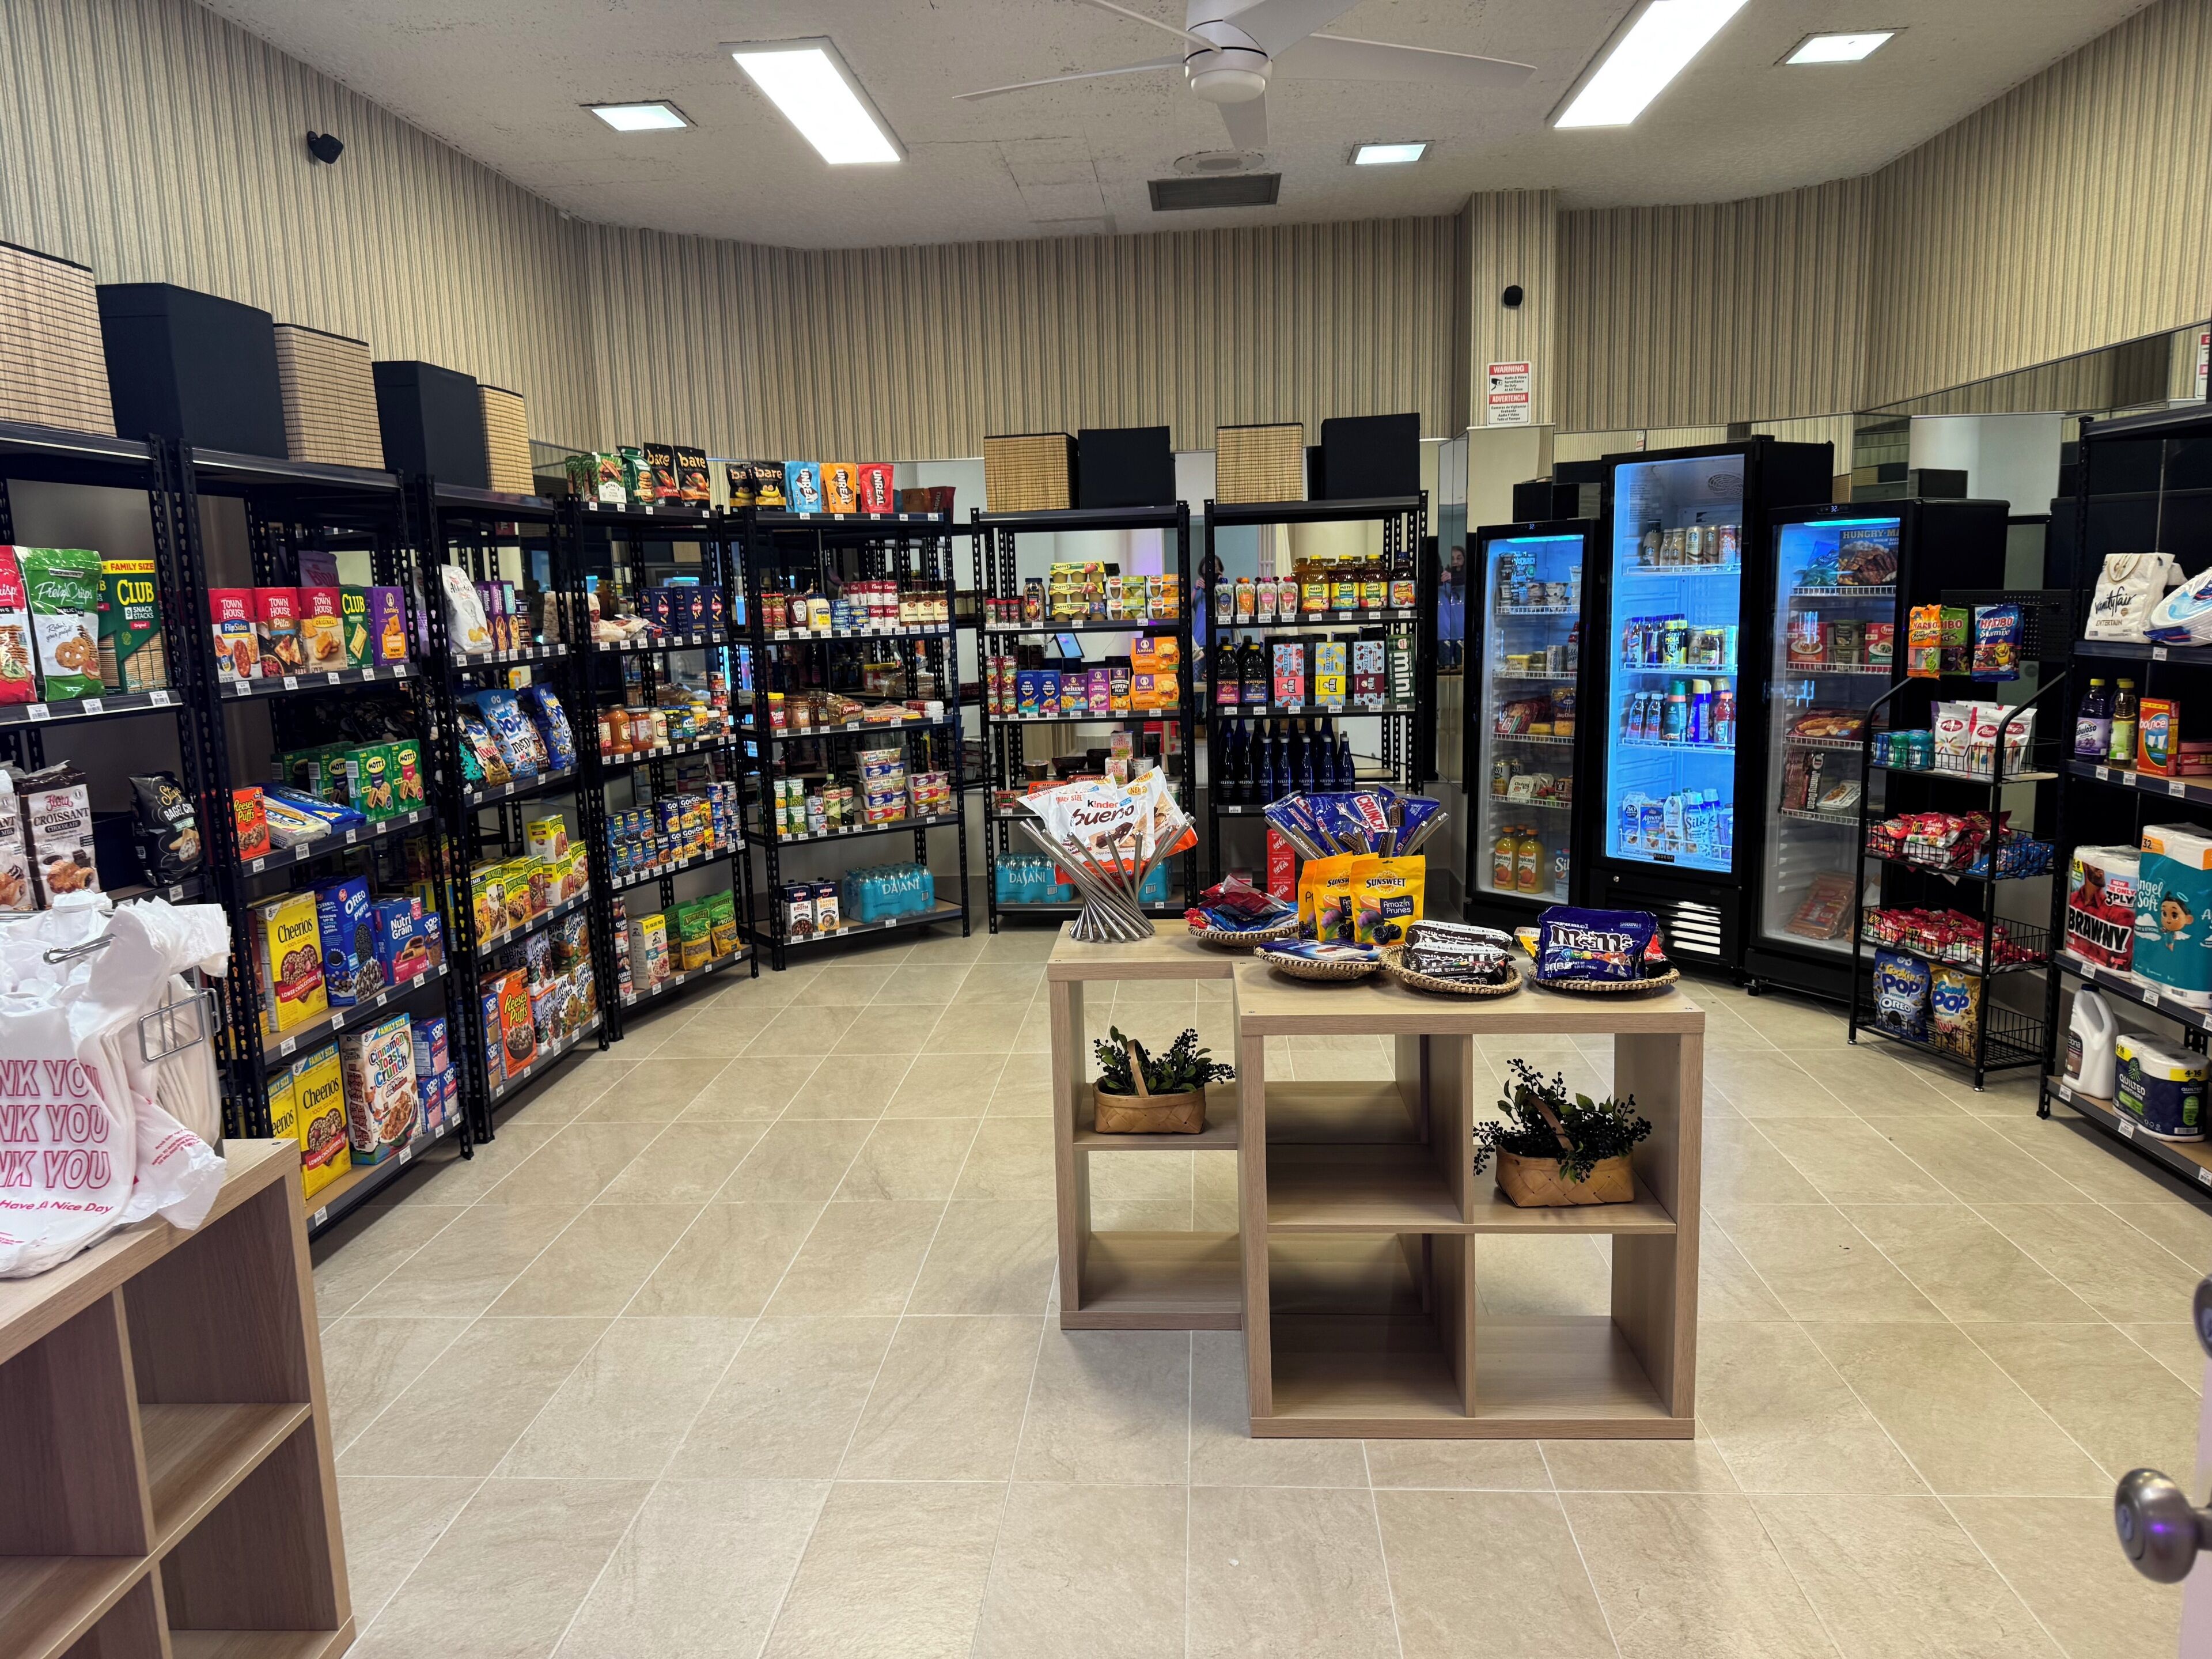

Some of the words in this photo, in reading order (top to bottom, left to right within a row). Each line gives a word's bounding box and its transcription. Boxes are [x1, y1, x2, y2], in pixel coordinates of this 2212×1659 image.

[1494, 365, 1525, 373] WARNING
[1492, 395, 1525, 403] ADVERTENCIA
[647, 449, 670, 466] bare
[678, 452, 706, 468] bare
[755, 467, 782, 479] bare
[800, 468, 817, 505] UNREAL
[835, 469, 853, 505] UNREAL
[873, 469, 883, 506] UNREAL
[111, 563, 137, 571] FAMILY
[138, 563, 154, 571] SIZE
[117, 579, 154, 605] CLUB
[221, 599, 243, 609] TOWN
[268, 598, 289, 608] TOWN
[313, 597, 331, 605] TOWN
[342, 594, 365, 614] CLUB
[127, 608, 132, 618] 9
[222, 608, 245, 619] HOUSE
[270, 607, 290, 617] HOUSE
[314, 605, 333, 615] HOUSE
[383, 607, 399, 615] Annie's
[225, 623, 247, 632] FlipSides
[274, 618, 290, 628] Pita
[1980, 618, 2014, 628] HARIBO
[1980, 629, 2011, 638] Starmix
[1394, 652, 1414, 698] mini
[2139, 717, 2166, 730] bounce
[400, 751, 416, 762] MOTT'S
[368, 760, 385, 770] MOTT'S
[1137, 772, 1152, 782] NEW!
[1808, 771, 1821, 794] Jimmy
[234, 800, 254, 812] Reese's
[1088, 800, 1118, 809] Kinder
[1807, 793, 1816, 809] Dean
[33, 807, 89, 827] CROISSANT
[164, 806, 183, 821] BAGEL
[237, 810, 255, 825] Puffs
[1072, 806, 1134, 825] bueno
[1290, 808, 1312, 831] CRUNCH
[1357, 796, 1385, 832] CRUNCH
[1642, 814, 1663, 823] Almond
[47, 821, 79, 832] CHOCOLATE
[1686, 815, 1707, 830] Silk
[1912, 821, 1923, 832] RITZ
[2142, 838, 2152, 850] 32
[1555, 857, 1570, 872] Sil
[882, 878, 920, 895] DASANI
[1009, 872, 1046, 887] DASANI
[1366, 877, 1407, 888] SUNSWEET
[345, 891, 366, 915] OREO
[2138, 891, 2158, 912] Soft
[354, 902, 369, 921] PUFFS
[1386, 906, 1411, 914] Prunes
[391, 914, 411, 931] Nutri
[718, 916, 734, 926] PROTEIN
[278, 917, 313, 944] Cheerios
[392, 925, 413, 941] Grain
[548, 925, 565, 935] Bites
[692, 930, 710, 940] CRUNCHY
[1885, 964, 1915, 982] Cookie
[281, 988, 295, 998] LOWER
[294, 975, 317, 992] CHOLESTEROL
[580, 975, 591, 992] Bites
[1936, 980, 1968, 995] Candy
[504, 990, 528, 1014] Reese's
[560, 986, 573, 1006] Bites
[1881, 998, 1911, 1013] OREO
[509, 1005, 528, 1027] Puffs
[377, 1023, 393, 1036] FAMILY
[394, 1017, 406, 1028] SIZE
[308, 1052, 324, 1066] FAMILY
[324, 1046, 335, 1056] SIZE
[369, 1035, 404, 1065] Cinnamon
[377, 1049, 402, 1070] Toast
[374, 1055, 408, 1088] Crunch
[2119, 1073, 2146, 1096] QUILTED
[2121, 1084, 2143, 1100] NORTHERN
[303, 1078, 339, 1110] Cheerios
[46, 1104, 109, 1143] YOU
[271, 1108, 294, 1138] eerios
[308, 1156, 321, 1166] LOWER
[321, 1140, 342, 1159] CHOLESTEROL
[44, 1149, 111, 1190] YOU
[0, 1199, 35, 1210] Have
[51, 1202, 82, 1211] Nice
[84, 1203, 113, 1215] Day
